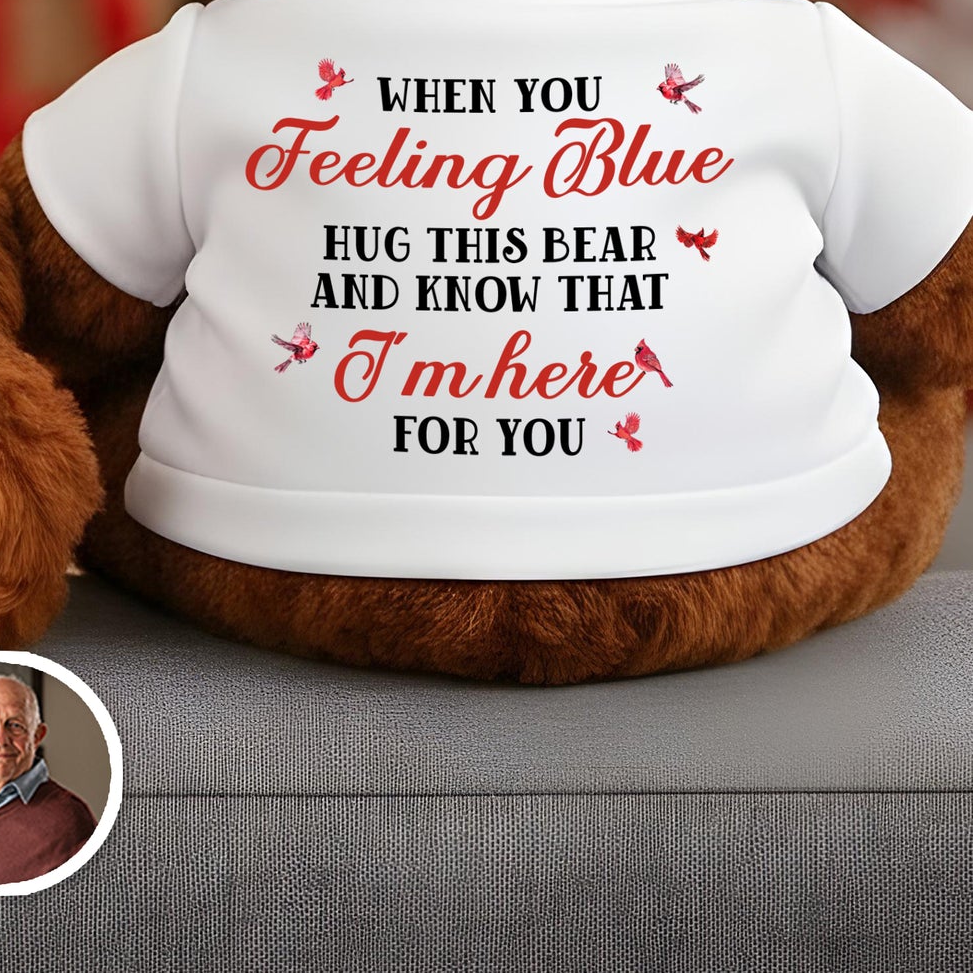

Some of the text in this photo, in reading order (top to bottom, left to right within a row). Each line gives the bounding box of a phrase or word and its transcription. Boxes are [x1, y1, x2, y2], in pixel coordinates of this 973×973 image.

[377, 76, 603, 114] WHEN YOU
[244, 115, 735, 220] Feeling Blue
[322, 224, 657, 264] HUG THIS BEAR
[310, 272, 670, 313] AND KNOW THAT
[333, 329, 647, 403] I'm here
[393, 415, 586, 457] FOR YOU
